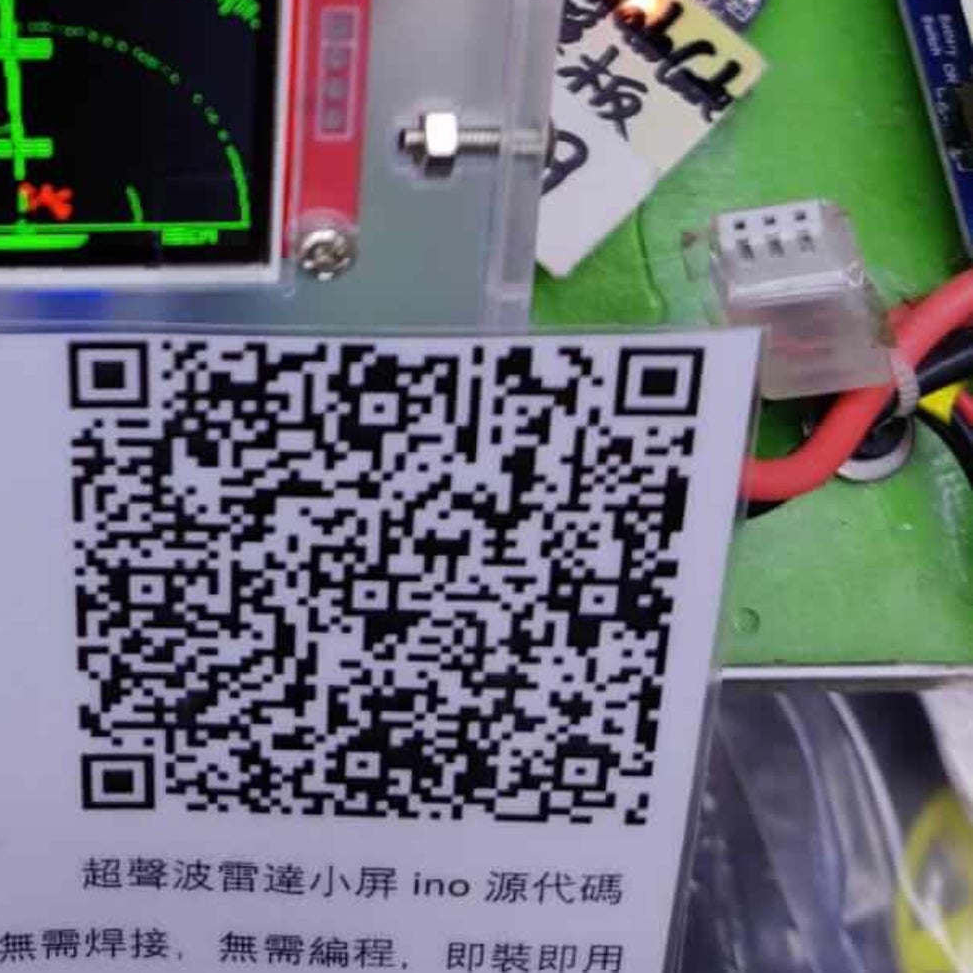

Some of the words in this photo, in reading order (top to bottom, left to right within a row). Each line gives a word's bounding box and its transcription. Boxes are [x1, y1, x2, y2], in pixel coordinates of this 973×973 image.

[83, 857, 398, 899] 超聲波雷達小屏
[412, 872, 470, 897] ino
[484, 870, 624, 905] 源代碼
[446, 941, 624, 973] 即裝即用
